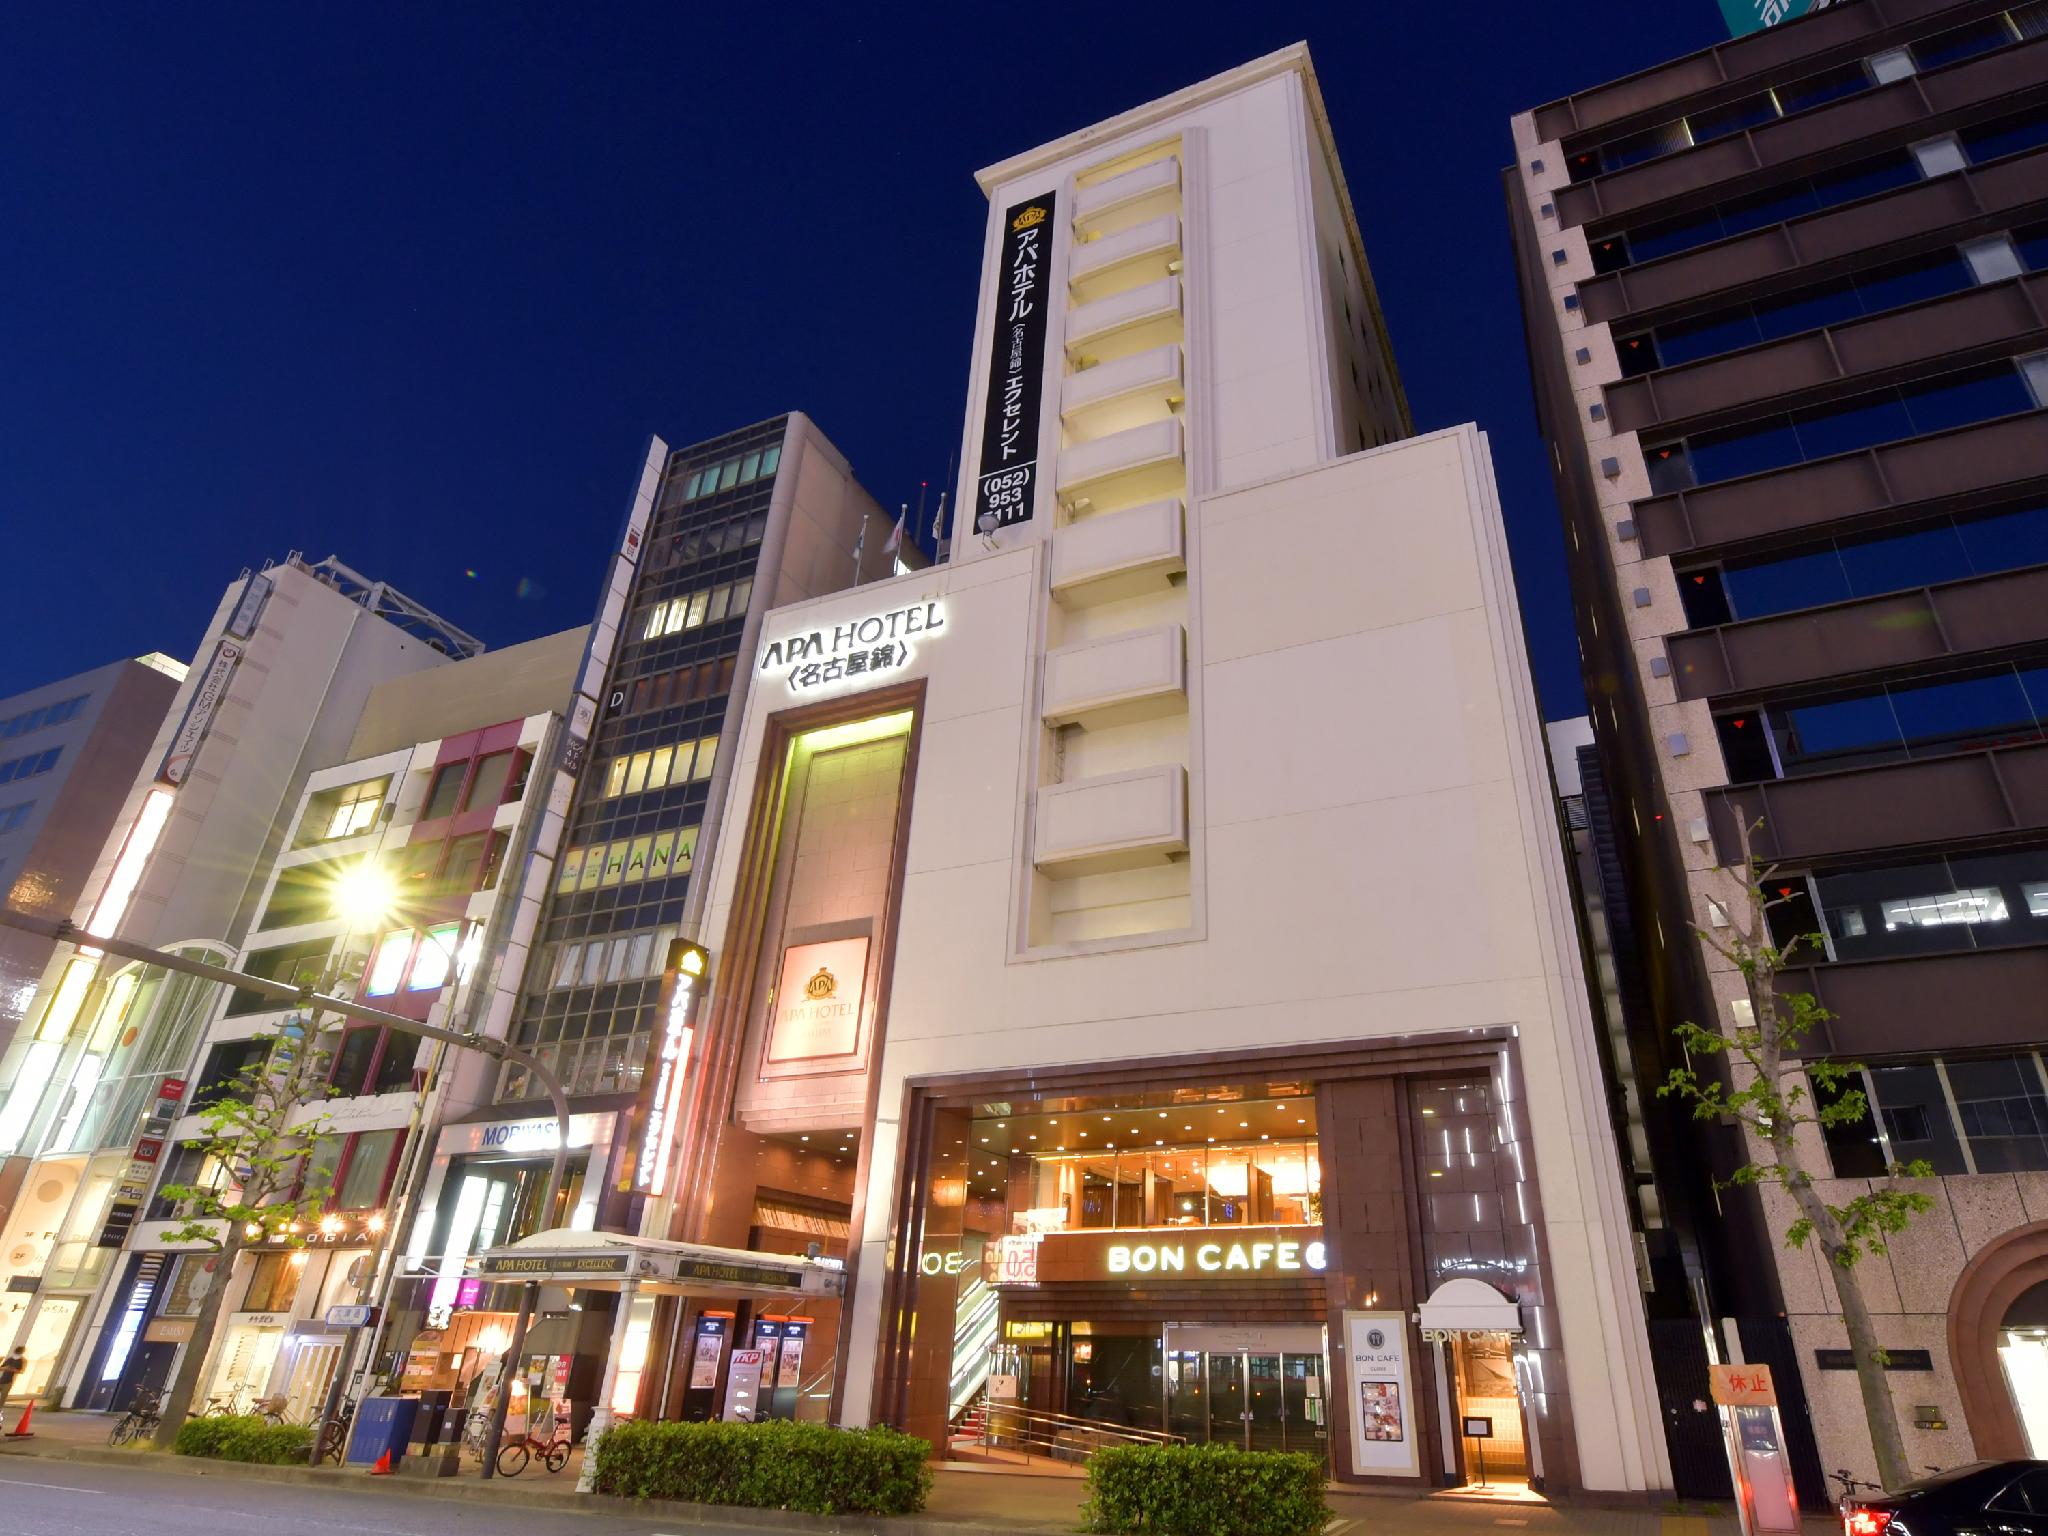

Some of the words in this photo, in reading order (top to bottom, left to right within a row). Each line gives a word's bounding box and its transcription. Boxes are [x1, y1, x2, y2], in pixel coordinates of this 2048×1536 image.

[1008, 228, 1039, 322] アパホテル
[1000, 375, 1023, 461] エクセレント
[984, 468, 1030, 496] (052)
[989, 487, 1022, 508] 953
[984, 502, 1024, 521] 111
[760, 632, 824, 670] APA
[832, 603, 944, 652] HOTEL
[610, 691, 624, 707] D
[606, 842, 691, 875] HANA
[809, 1003, 856, 1019] HOTEL
[495, 1259, 515, 1271] APA
[516, 1259, 548, 1271] HOTEL
[1108, 1245, 1185, 1272] BON
[1196, 1243, 1300, 1270] CAFE
[1423, 1329, 1461, 1343] BON
[1377, 1354, 1400, 1362] CAFE
[1728, 1373, 1768, 1393] 休止
